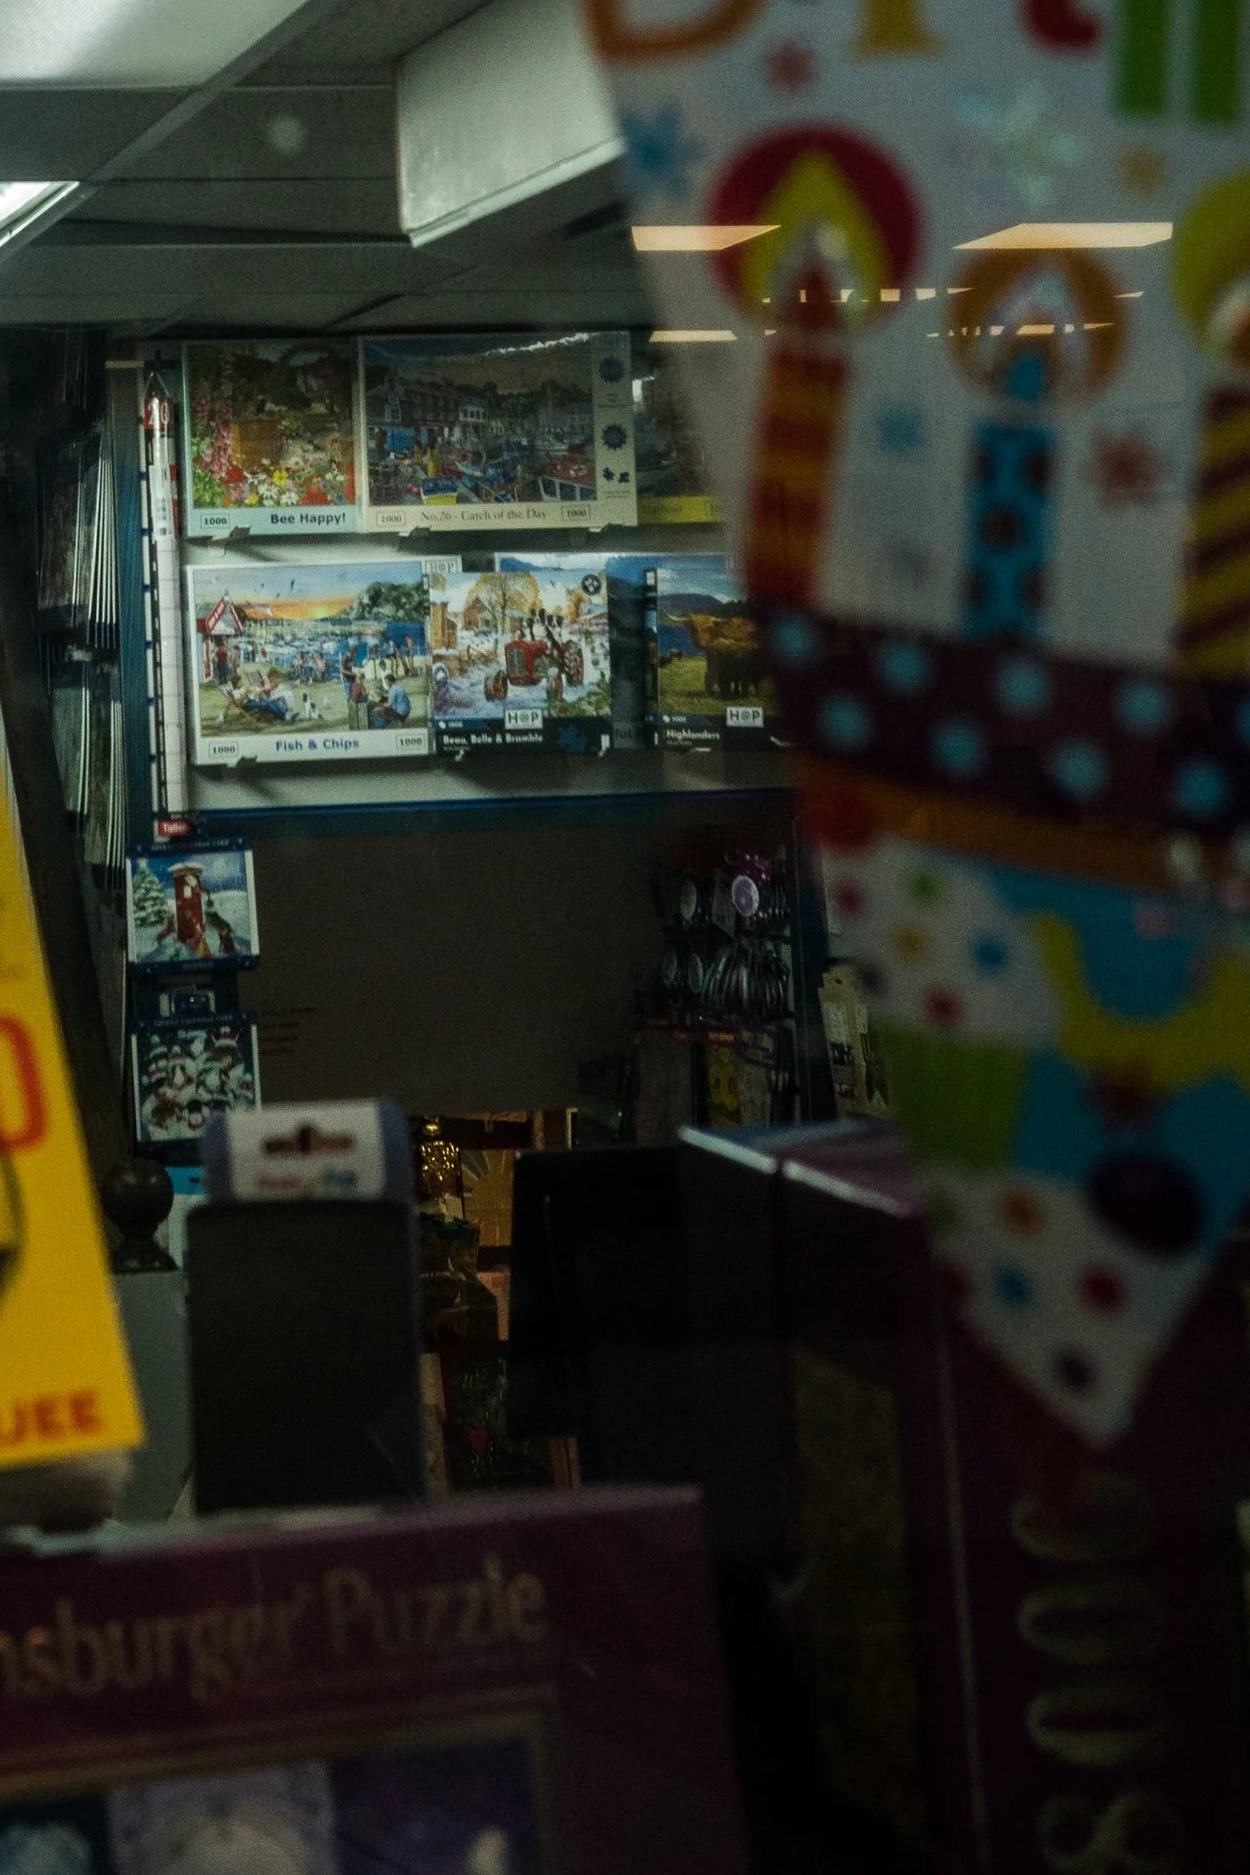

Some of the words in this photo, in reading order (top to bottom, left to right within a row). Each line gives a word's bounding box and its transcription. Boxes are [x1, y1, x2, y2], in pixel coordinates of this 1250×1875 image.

[203, 516, 228, 525] 1000
[270, 512, 295, 525] Bee
[300, 512, 347, 527] Happy!
[460, 510, 491, 521] Catch
[493, 510, 504, 520] of
[507, 509, 524, 519] the
[525, 507, 547, 520] Day
[565, 508, 587, 519] 1000
[496, 733, 504, 744] &
[505, 732, 544, 744] Bramble
[666, 728, 721, 742] Highlanders
[212, 745, 236, 754] 1000
[275, 737, 303, 752] Fish
[308, 738, 318, 750] &
[322, 737, 360, 751] Chips
[399, 736, 423, 747] 1000
[322, 1549, 548, 1660] Puzzle
